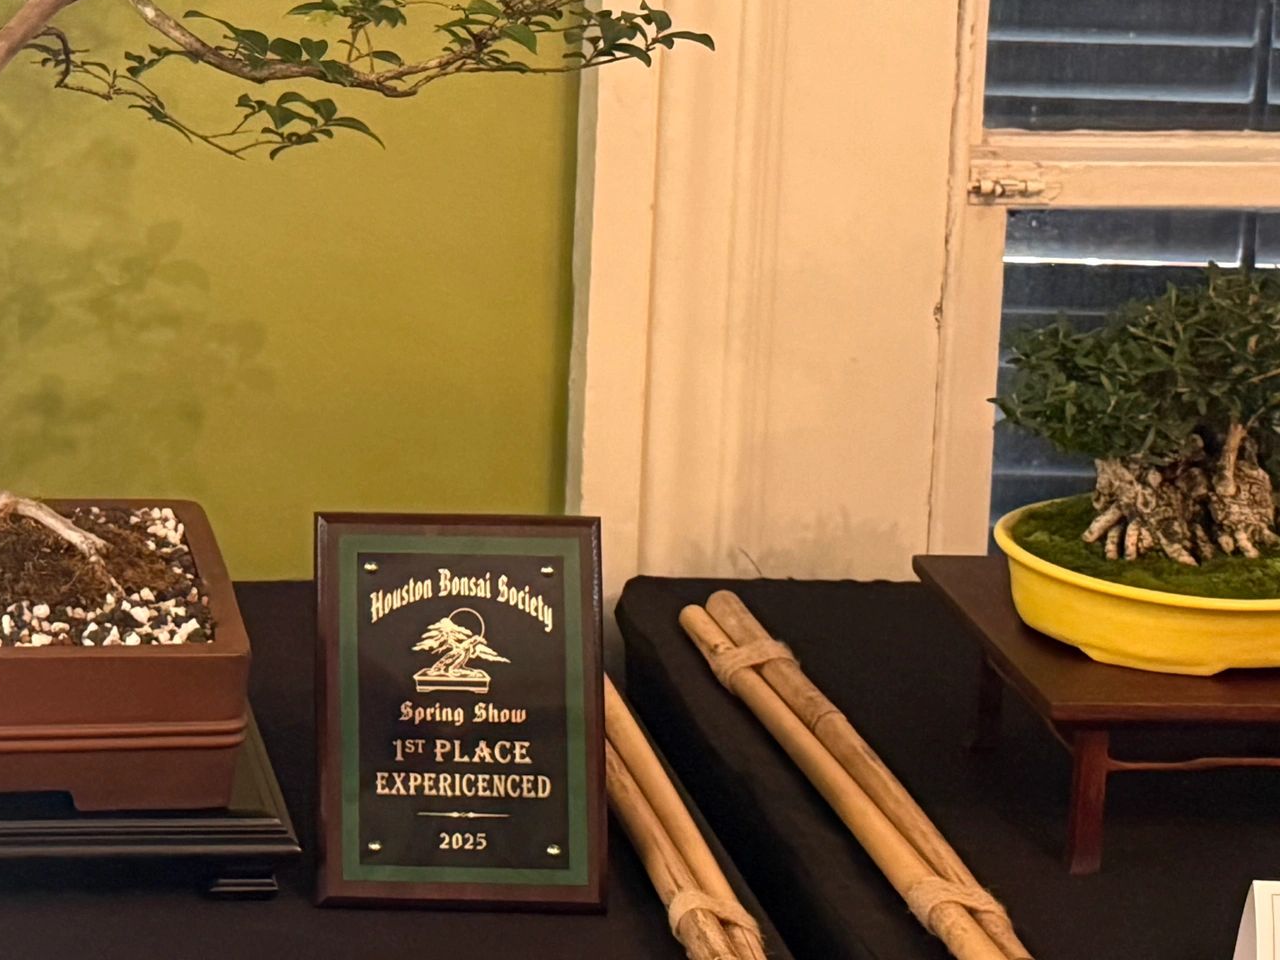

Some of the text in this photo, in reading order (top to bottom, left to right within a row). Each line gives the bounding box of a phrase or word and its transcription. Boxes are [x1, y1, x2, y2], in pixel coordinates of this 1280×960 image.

[370, 568, 553, 633] Houston Bonsai Society
[399, 701, 527, 725] Spring Show
[392, 739, 532, 764] 1ST PLACE
[376, 772, 552, 799] EXPERICENCED
[438, 832, 487, 850] 2025
